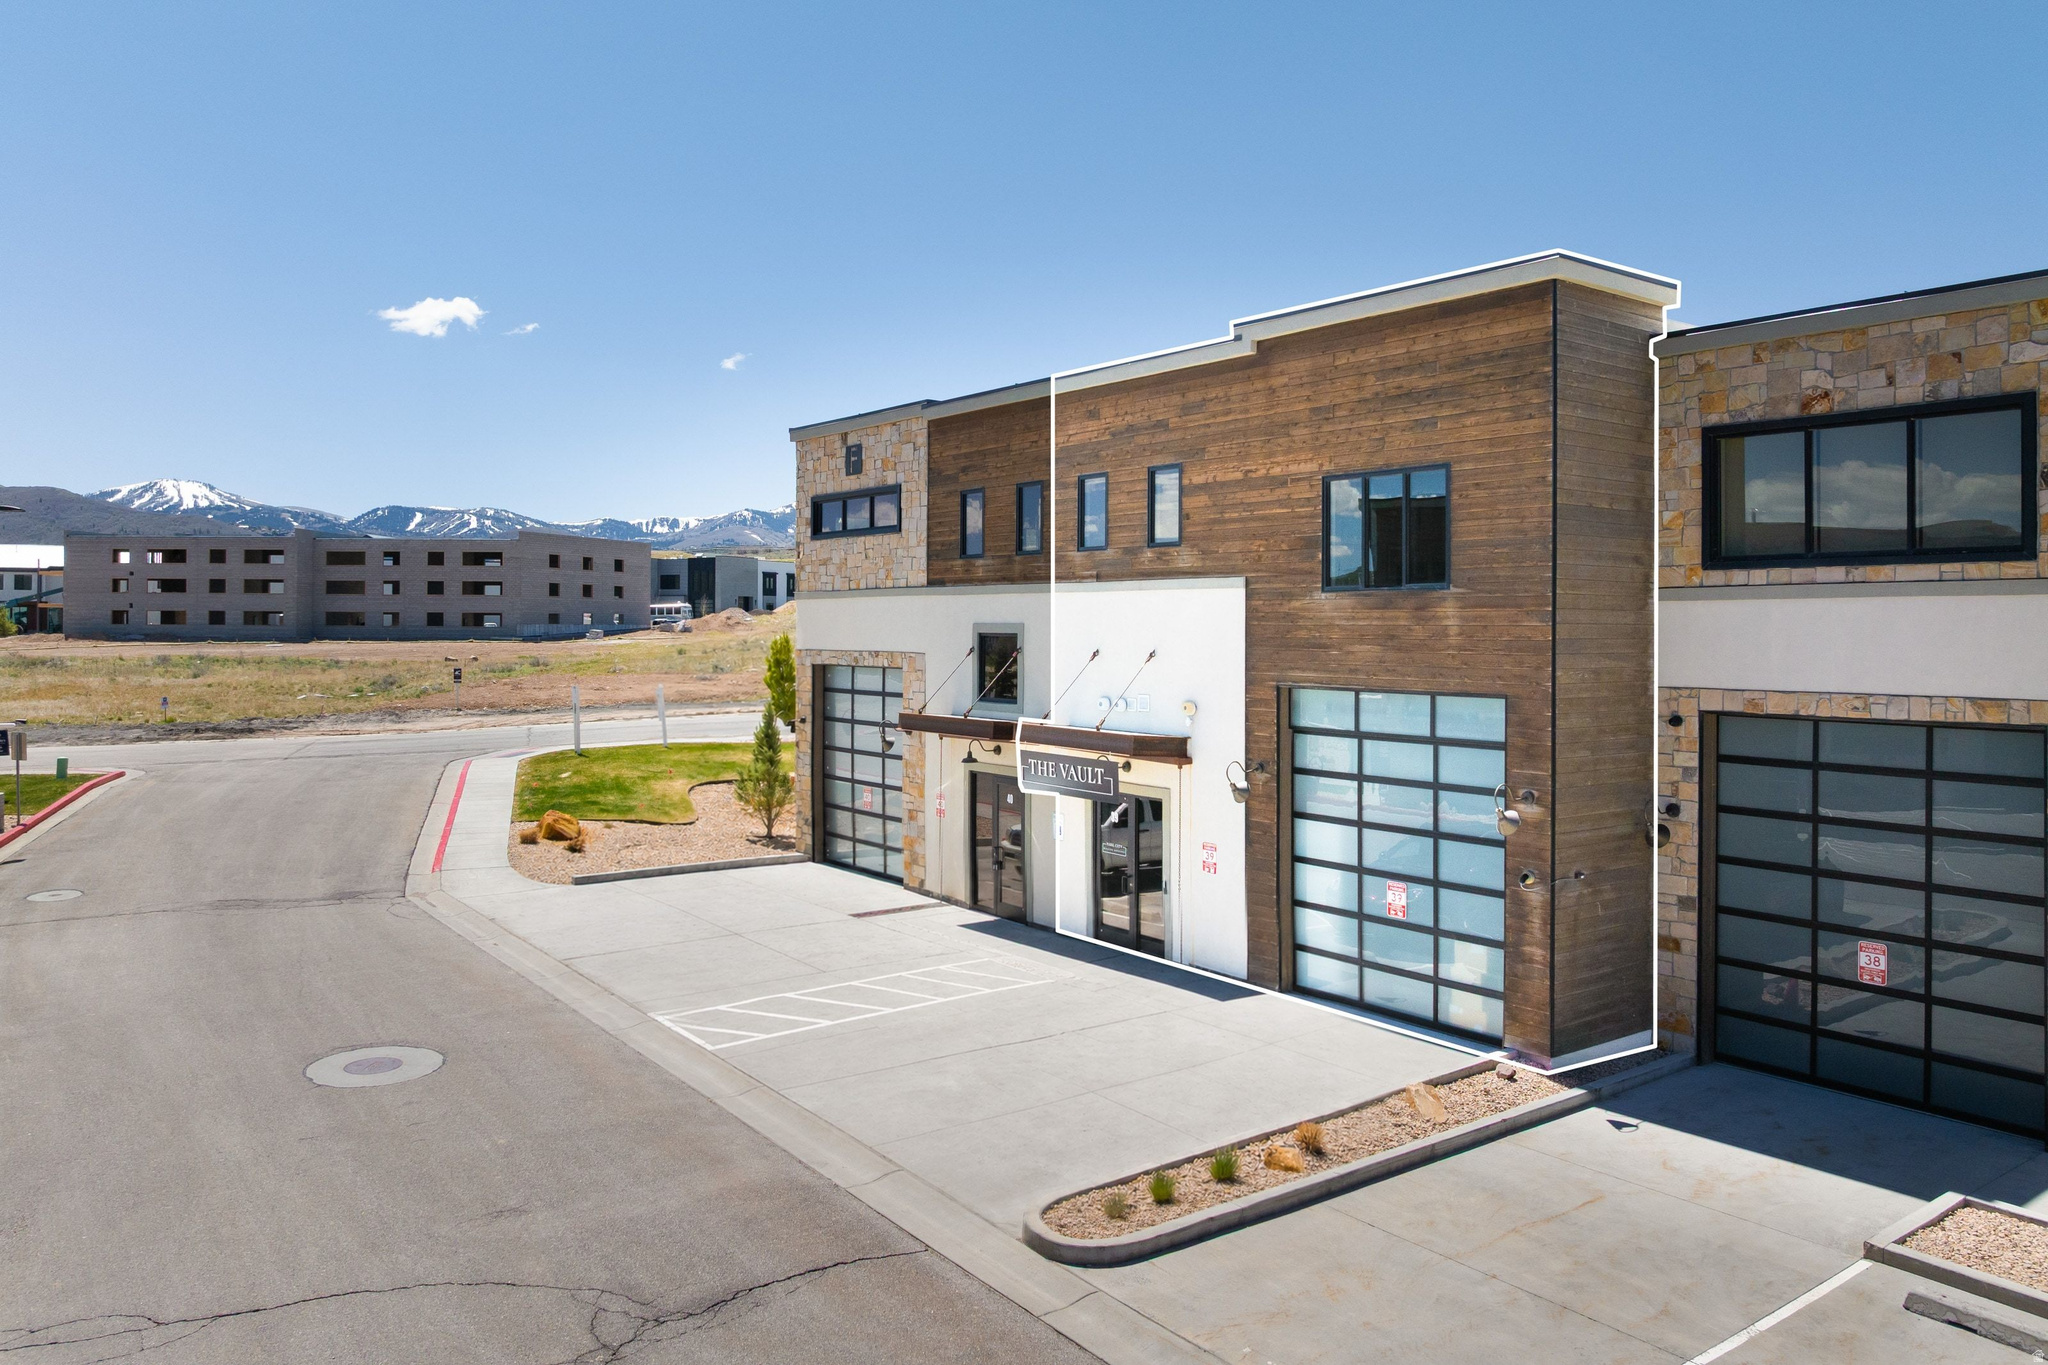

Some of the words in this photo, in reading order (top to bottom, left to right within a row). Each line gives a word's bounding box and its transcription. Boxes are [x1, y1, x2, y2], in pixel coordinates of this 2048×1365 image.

[850, 447, 858, 474] F
[1028, 758, 1056, 778] THE
[1059, 763, 1104, 785] VAULT
[1205, 851, 1215, 861] 39
[1860, 942, 1886, 950] RESERVED
[1862, 947, 1884, 955] PARKING
[1864, 954, 1880, 967] 38
